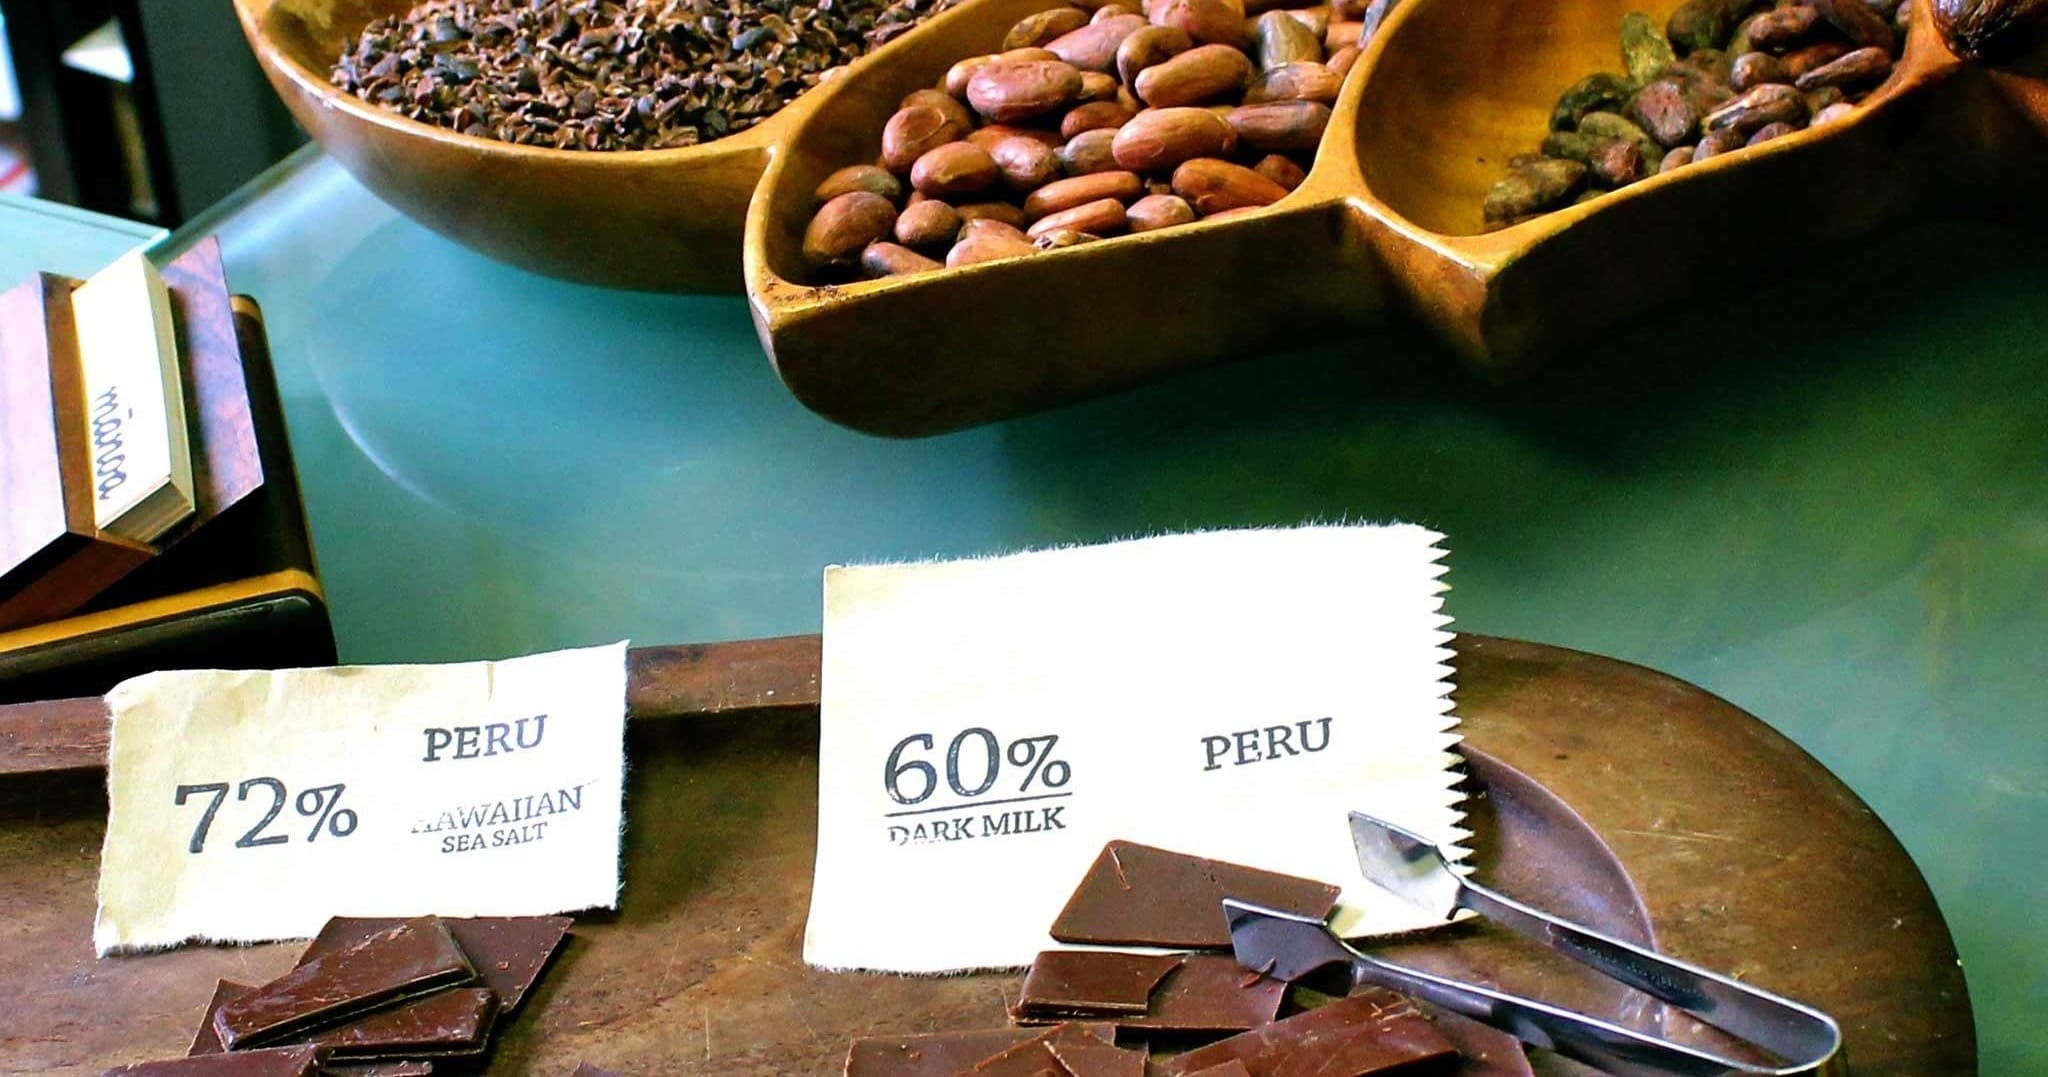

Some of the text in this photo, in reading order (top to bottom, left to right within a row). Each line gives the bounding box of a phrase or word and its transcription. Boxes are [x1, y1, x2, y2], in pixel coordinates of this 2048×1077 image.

[421, 714, 548, 763] PERU
[1200, 716, 1333, 772] PERU
[884, 726, 1072, 806] 60%
[174, 776, 359, 855] 72%
[441, 821, 548, 854] SEA SALT
[887, 805, 1067, 847] DARK MILK
